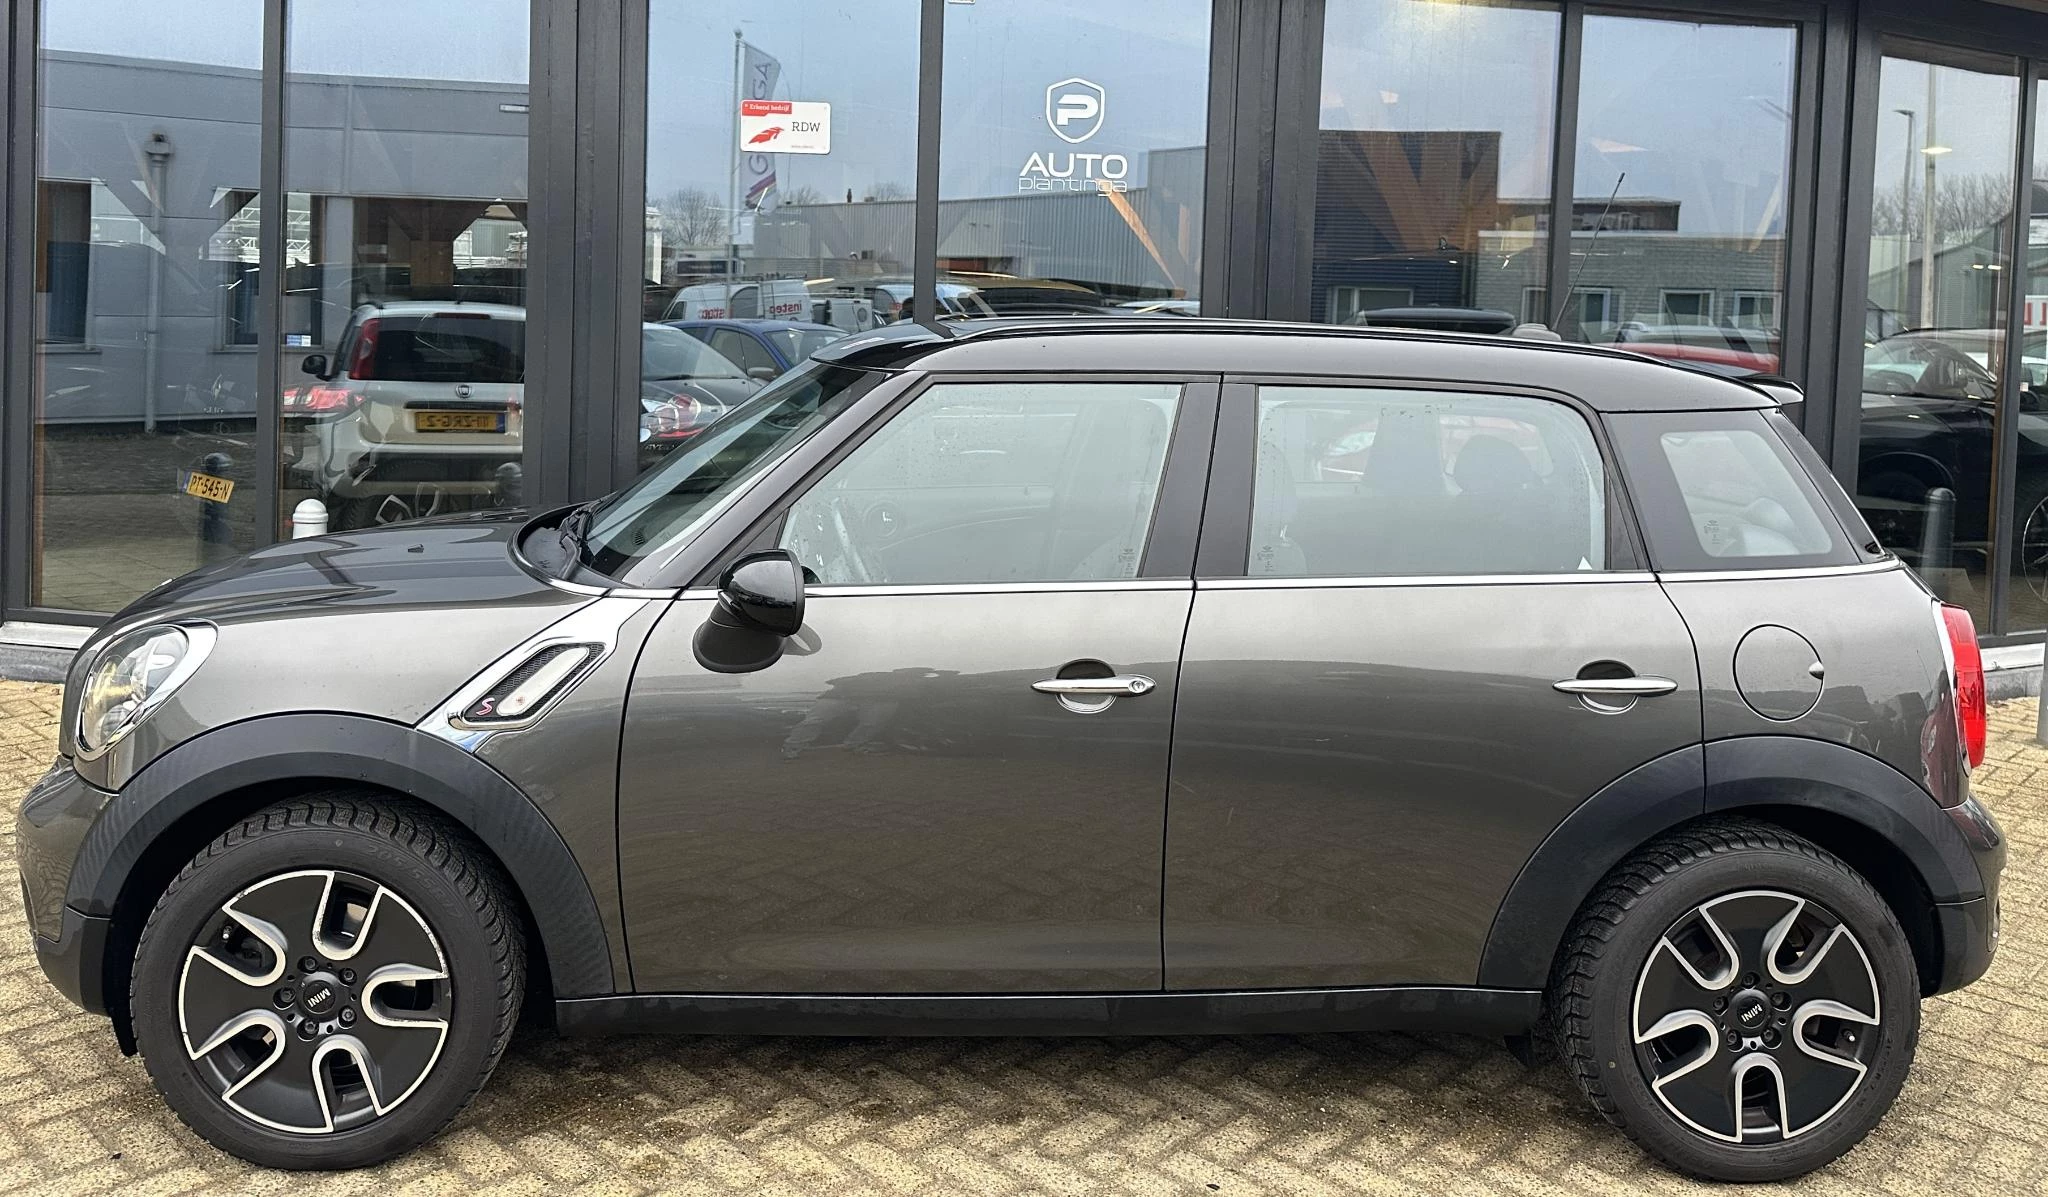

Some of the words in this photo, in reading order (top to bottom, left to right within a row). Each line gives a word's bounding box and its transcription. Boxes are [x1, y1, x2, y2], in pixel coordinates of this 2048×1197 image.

[749, 103, 770, 111] Erkend
[1056, 93, 1099, 126] P
[791, 121, 821, 132] RDW
[1019, 151, 1128, 179] AUTO
[1018, 176, 1128, 197] plantinga
[189, 475, 231, 500] PT-545-N
[475, 697, 496, 716] S
[307, 988, 331, 1008] MINI
[1741, 1003, 1763, 1022] MINI
